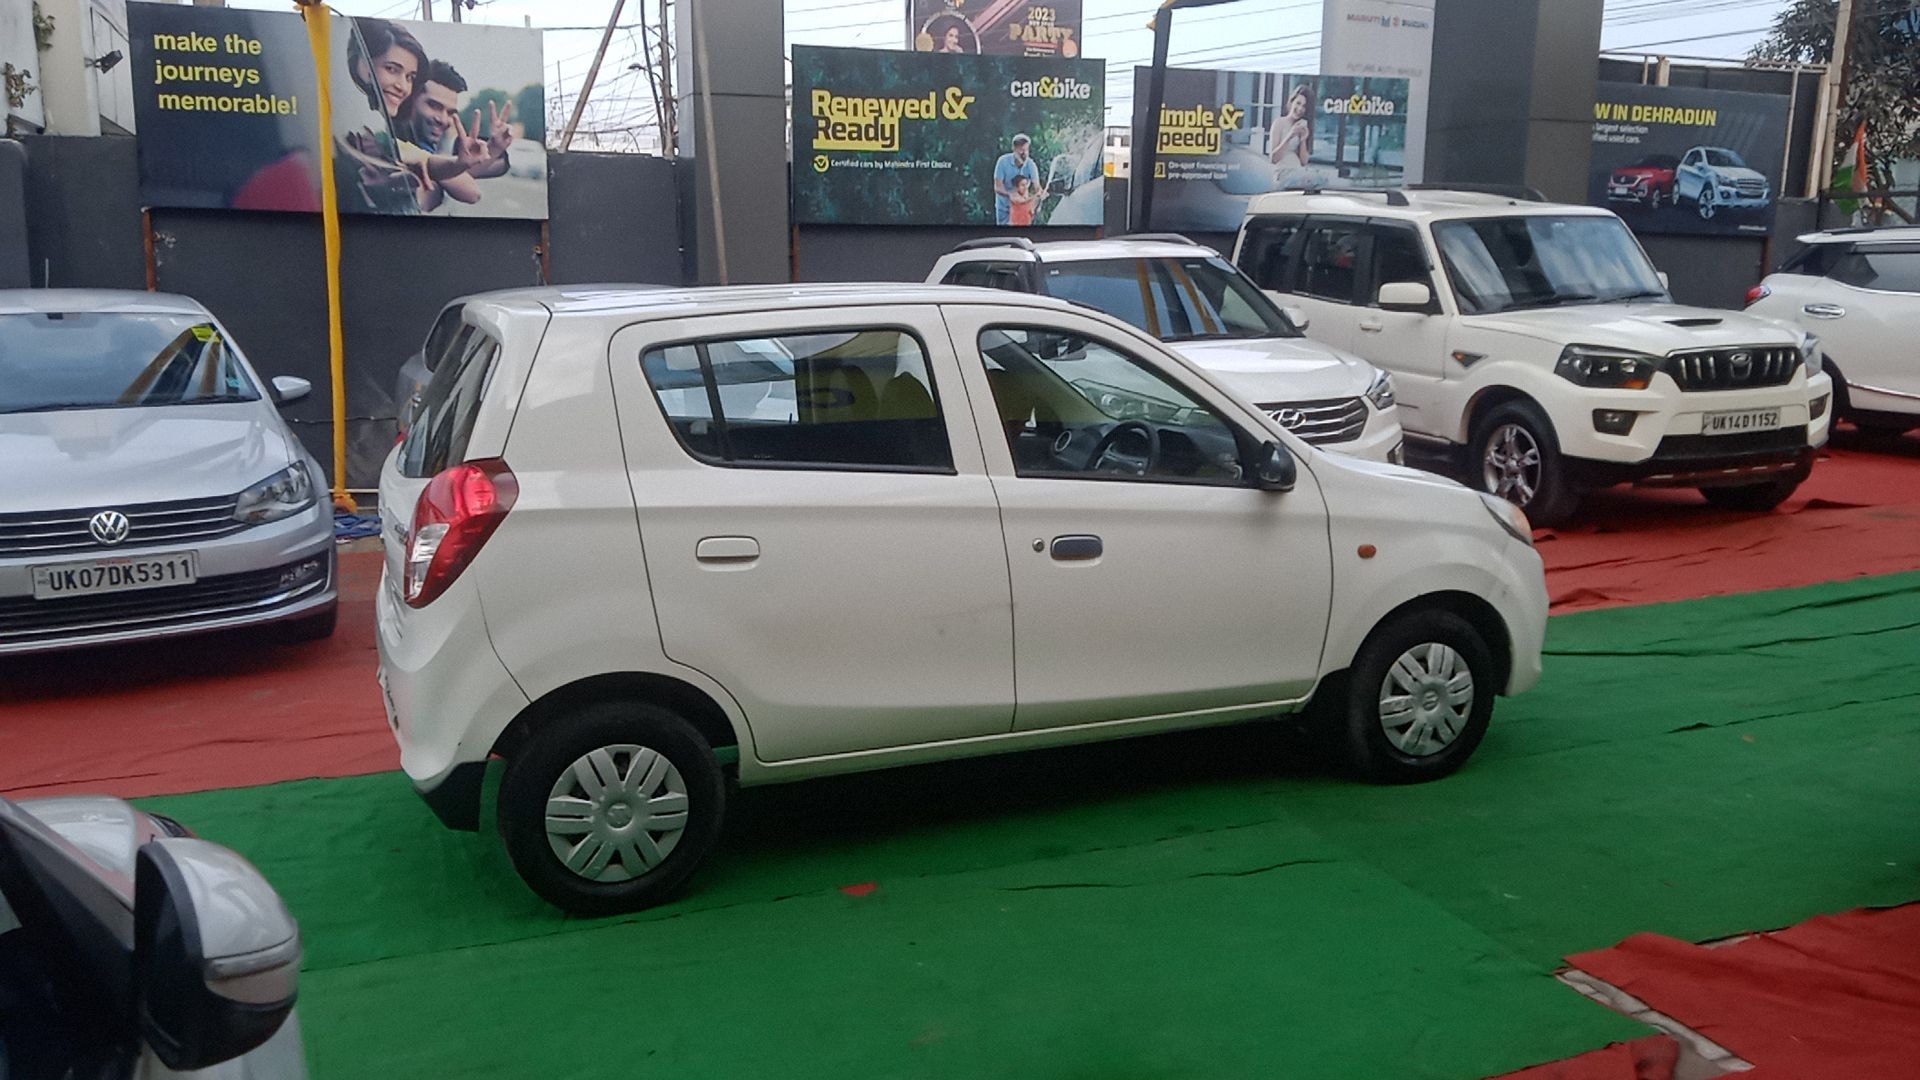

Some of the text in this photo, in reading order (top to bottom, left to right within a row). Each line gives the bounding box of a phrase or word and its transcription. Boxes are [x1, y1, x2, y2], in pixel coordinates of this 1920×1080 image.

[1027, 6, 1057, 21] 2023
[154, 31, 262, 55] make the
[1009, 23, 1073, 43] PARTY
[155, 60, 261, 88] journeys
[1010, 76, 1091, 99] car&bike
[158, 93, 298, 115] memorable!
[812, 86, 975, 120] Renewed &
[1324, 95, 1395, 115] car&bike
[1594, 103, 1718, 126] W IN DEHRADUN
[1159, 103, 1244, 130] imple &
[815, 115, 896, 149] Ready
[1158, 127, 1218, 152] peedy
[830, 158, 859, 168] Certified
[859, 160, 874, 168] cars
[874, 160, 884, 170] by
[915, 160, 930, 169] First
[931, 160, 953, 169] Choice
[1712, 412, 1777, 430] UK14D1152
[49, 559, 190, 591] UK07DK5311
